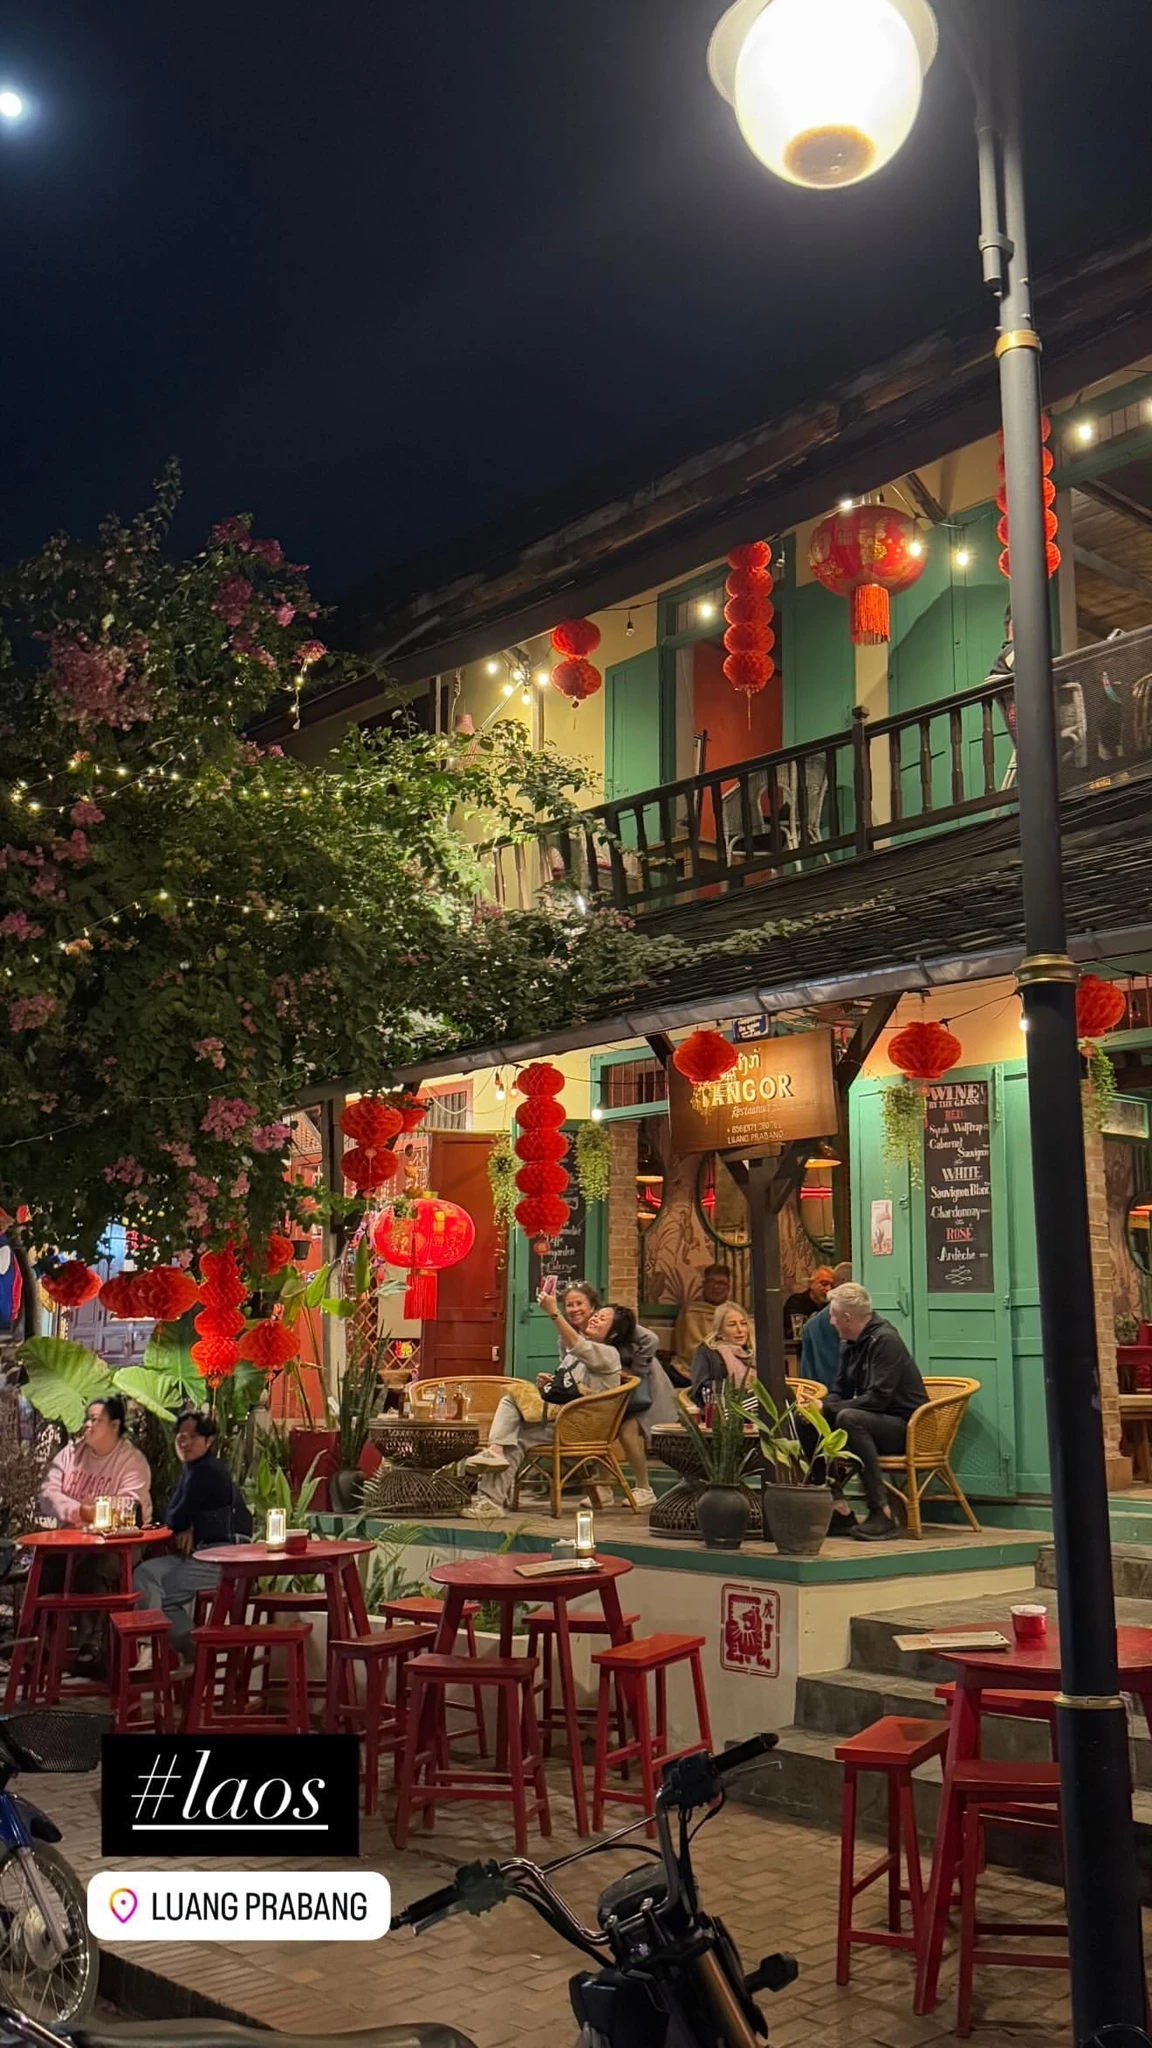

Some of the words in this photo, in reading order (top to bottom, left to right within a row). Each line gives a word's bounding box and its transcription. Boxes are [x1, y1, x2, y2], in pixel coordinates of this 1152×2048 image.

[953, 1097, 979, 1107] GLASS
[942, 1166, 983, 1180] WHITE
[930, 1204, 980, 1221] Chardonnay
